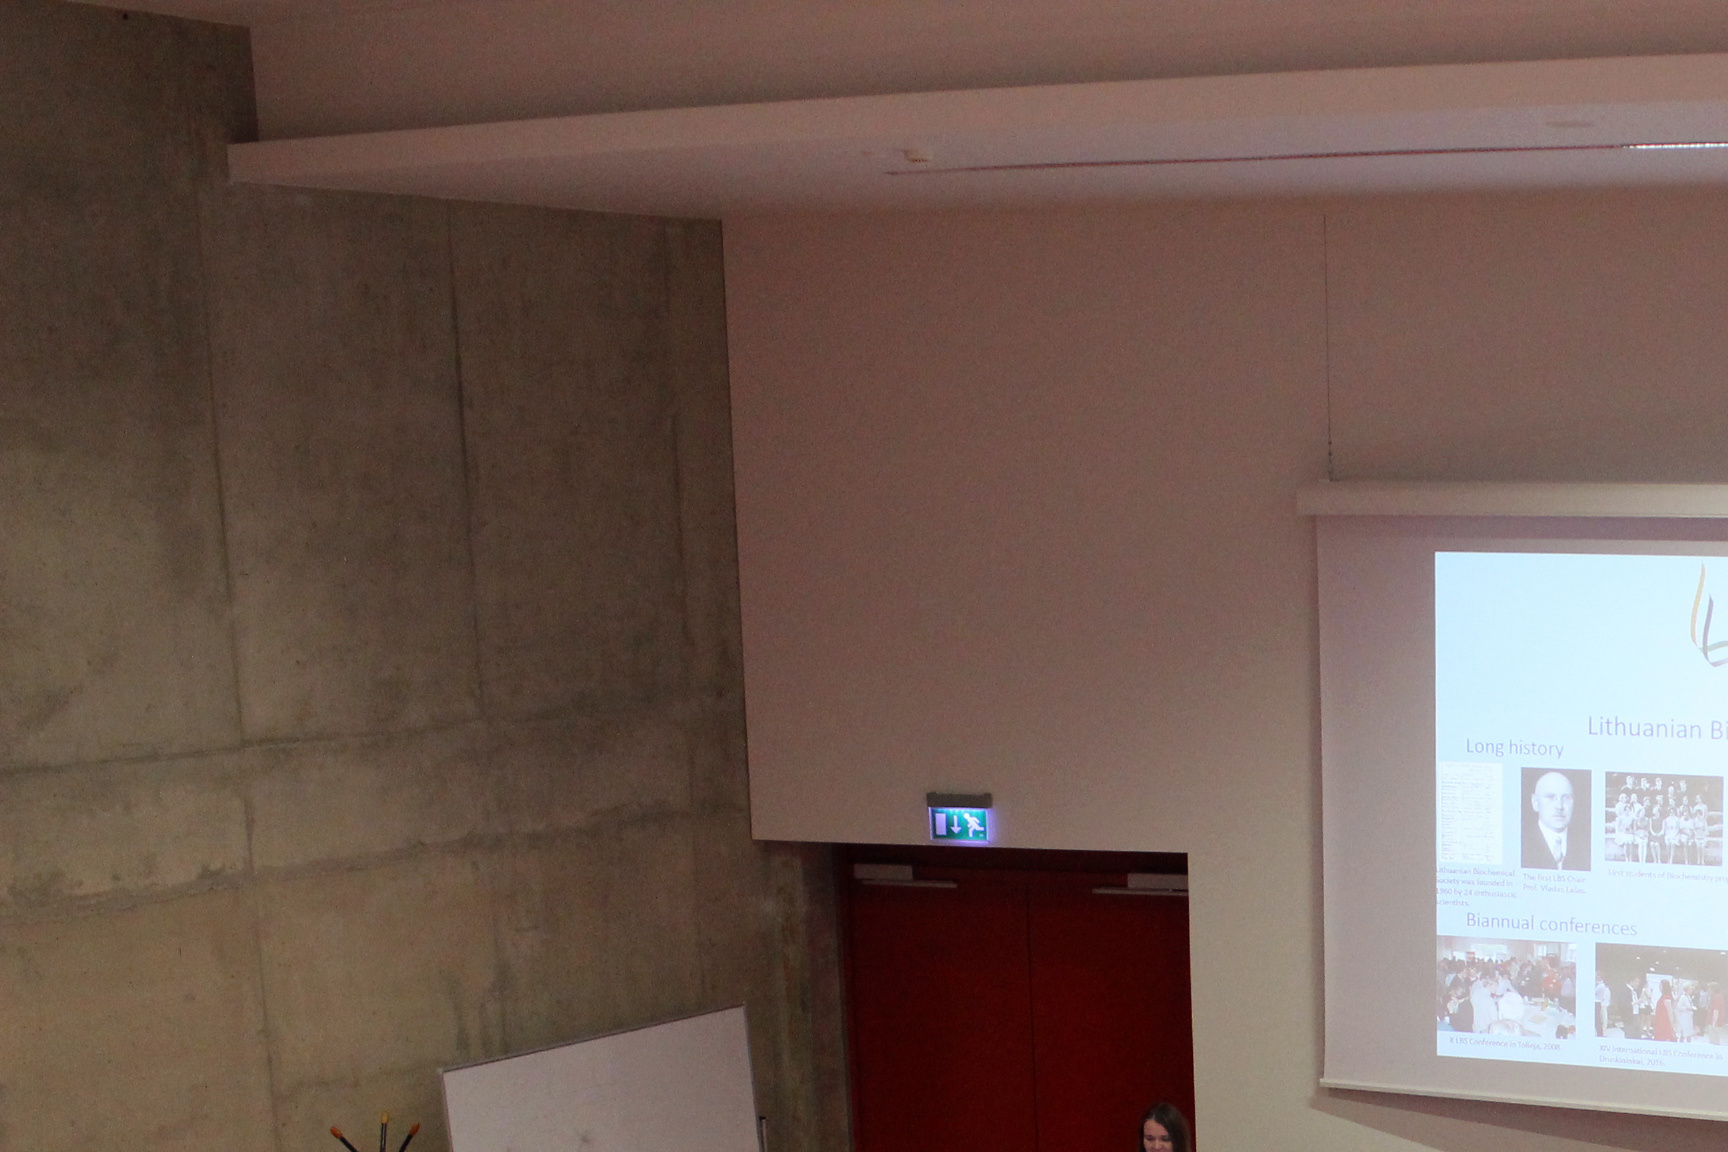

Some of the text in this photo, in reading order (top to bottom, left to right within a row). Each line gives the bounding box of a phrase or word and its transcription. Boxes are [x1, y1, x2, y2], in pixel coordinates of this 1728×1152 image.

[1588, 716, 1702, 739] Lithuanian
[1466, 738, 1565, 759] Long history
[1473, 867, 1516, 877] Biochemical
[1477, 878, 1505, 887] founded
[1454, 888, 1462, 897] by
[1464, 889, 1472, 897] 24
[1466, 912, 1638, 937] Biannual conferences
